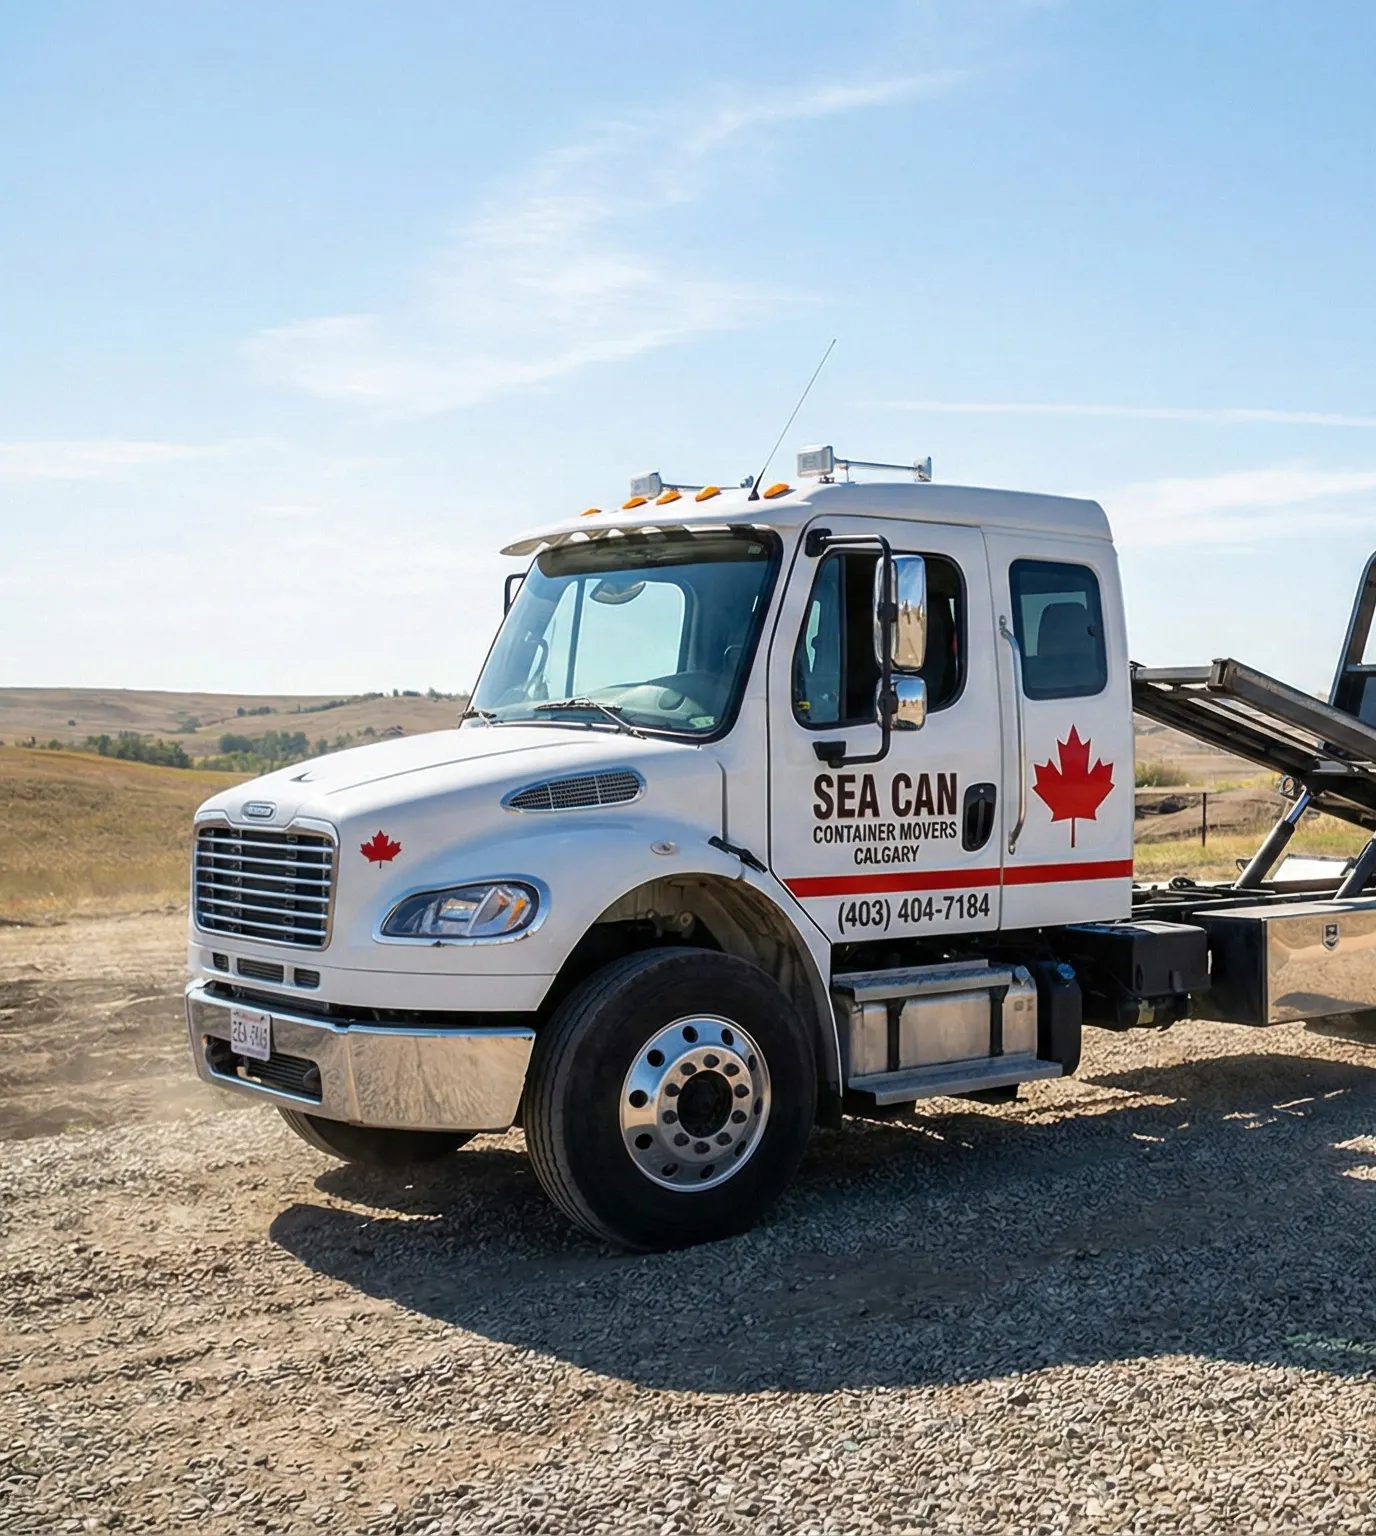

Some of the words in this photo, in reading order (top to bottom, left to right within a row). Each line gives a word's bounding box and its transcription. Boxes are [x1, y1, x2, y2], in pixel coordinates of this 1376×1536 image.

[813, 774, 880, 820] SEA
[891, 773, 957, 817] CAN
[813, 823, 896, 844] CONTAINER
[899, 821, 957, 841] MOVERS
[854, 845, 920, 865] CALGARY
[838, 899, 891, 934] (403)
[898, 893, 990, 922] 404-7184
